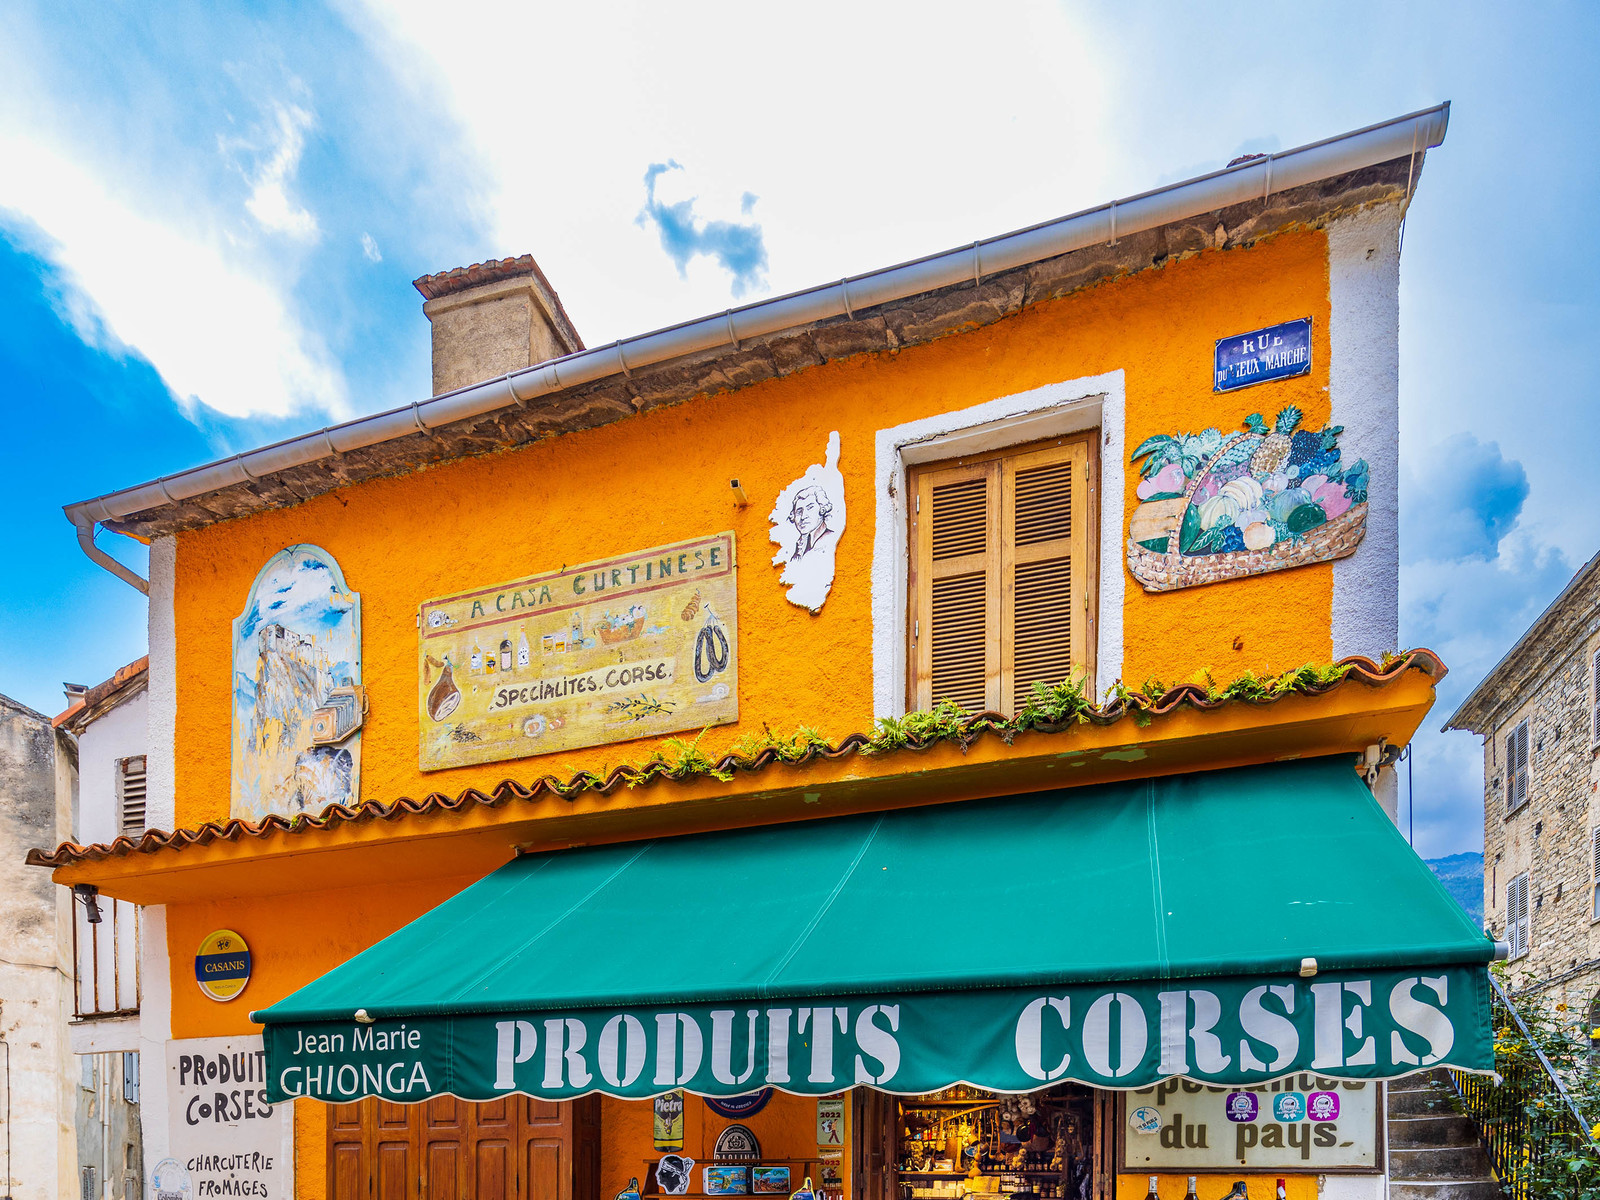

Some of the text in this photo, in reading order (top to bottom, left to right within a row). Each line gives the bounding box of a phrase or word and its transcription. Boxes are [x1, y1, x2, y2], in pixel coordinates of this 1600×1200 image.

[1217, 369, 1228, 383] DU
[470, 546, 721, 618] A CASA CURTINESE
[204, 960, 245, 973] CASANIS
[293, 1024, 421, 1055] Jean Marie
[493, 975, 1455, 1090] PRODUITS CORSES
[179, 1051, 267, 1086] PRODUIT
[280, 1061, 432, 1096] GHIONGA
[655, 1099, 683, 1112] Pietra
[1160, 1114, 1209, 1148] du
[187, 1151, 273, 1173] CHARCUTERIE
[199, 1179, 268, 1198] FROMAGES
